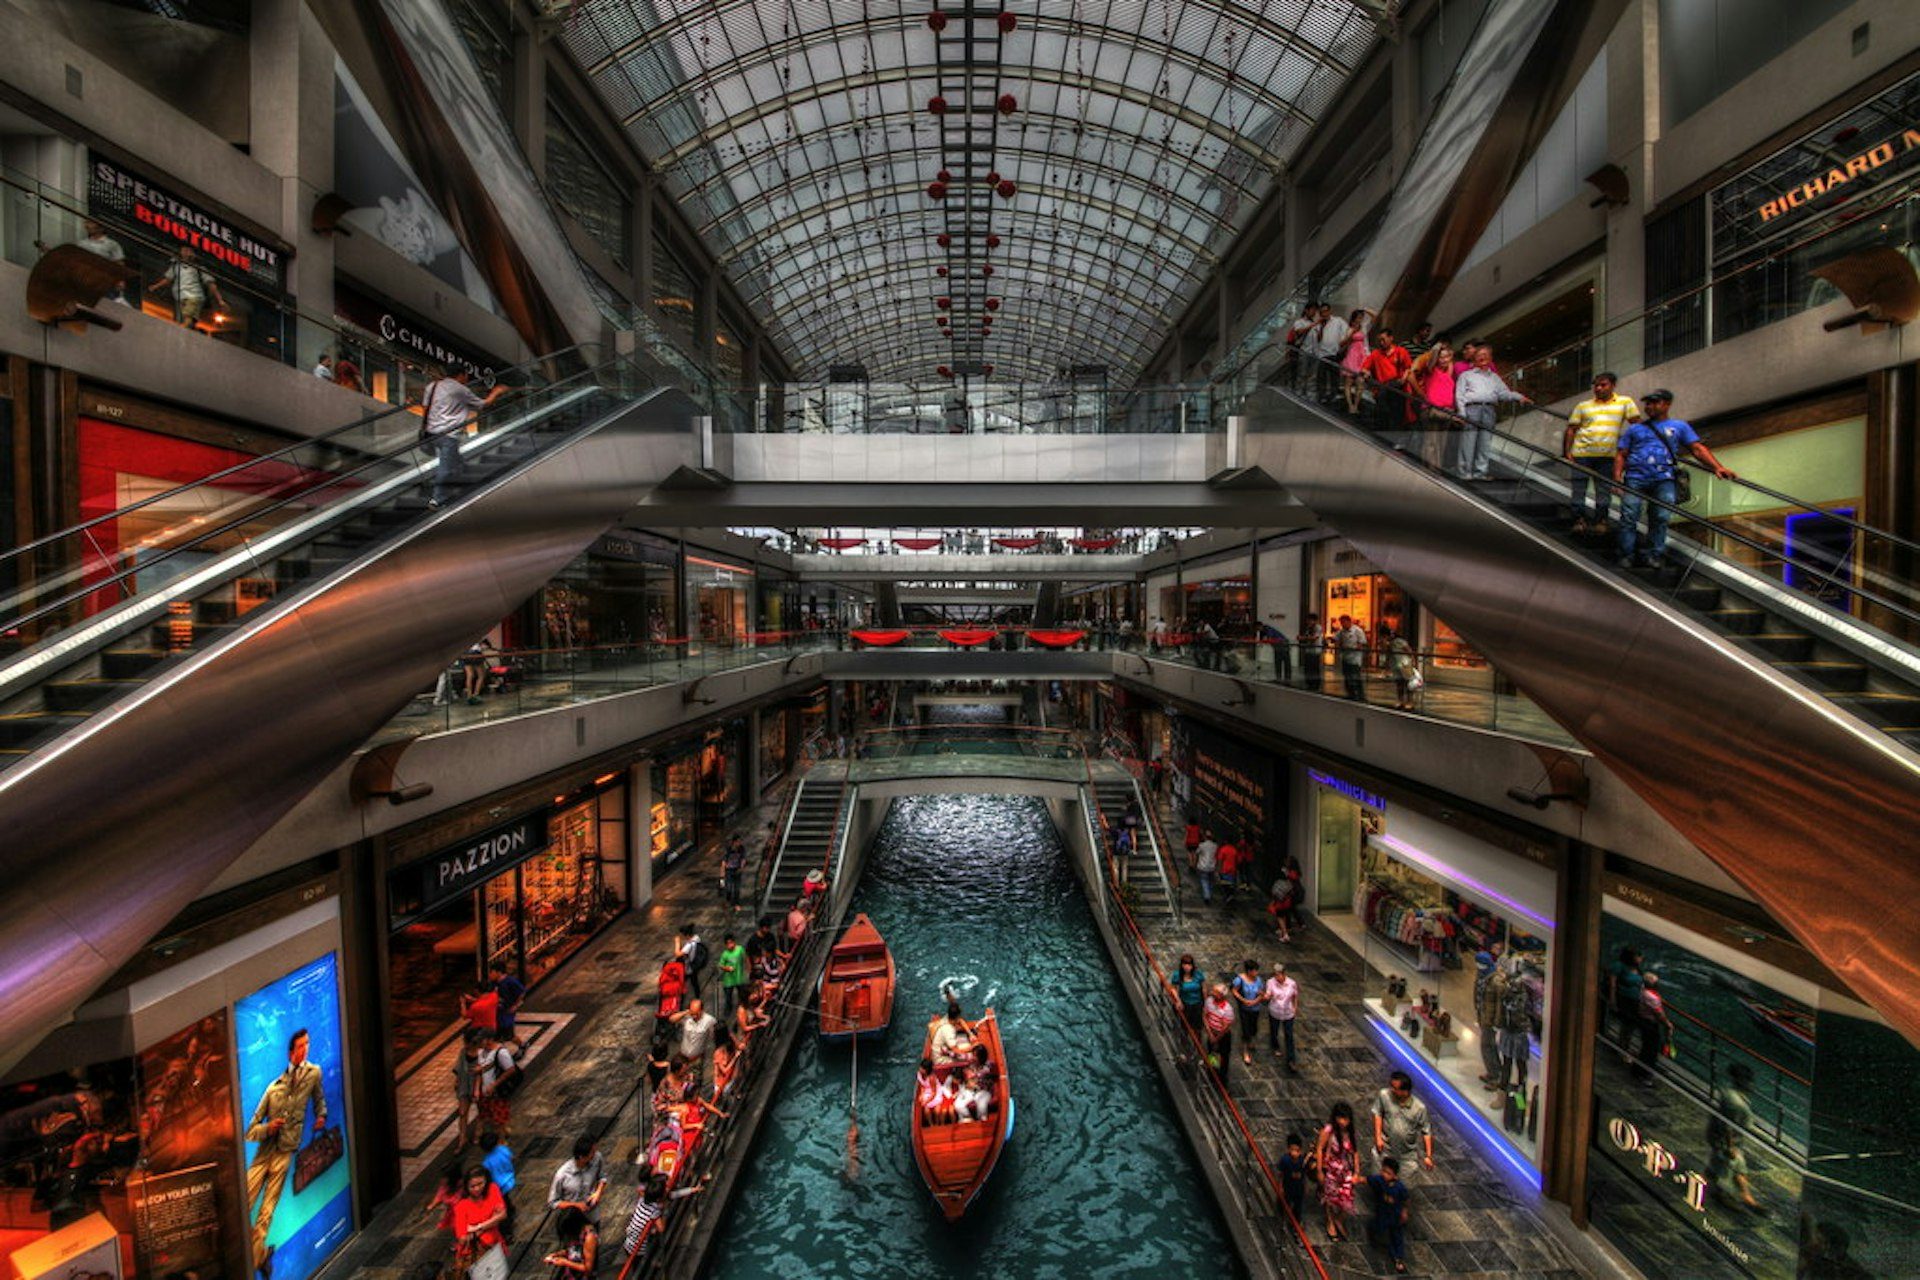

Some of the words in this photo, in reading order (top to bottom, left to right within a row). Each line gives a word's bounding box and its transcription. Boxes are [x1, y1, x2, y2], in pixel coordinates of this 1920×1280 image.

[97, 162, 233, 245] SPECTACLE
[239, 236, 278, 266] HUT
[1758, 142, 1894, 222] RICHARD
[134, 202, 252, 272] BOUTIQUE
[440, 826, 526, 887] PAZZION
